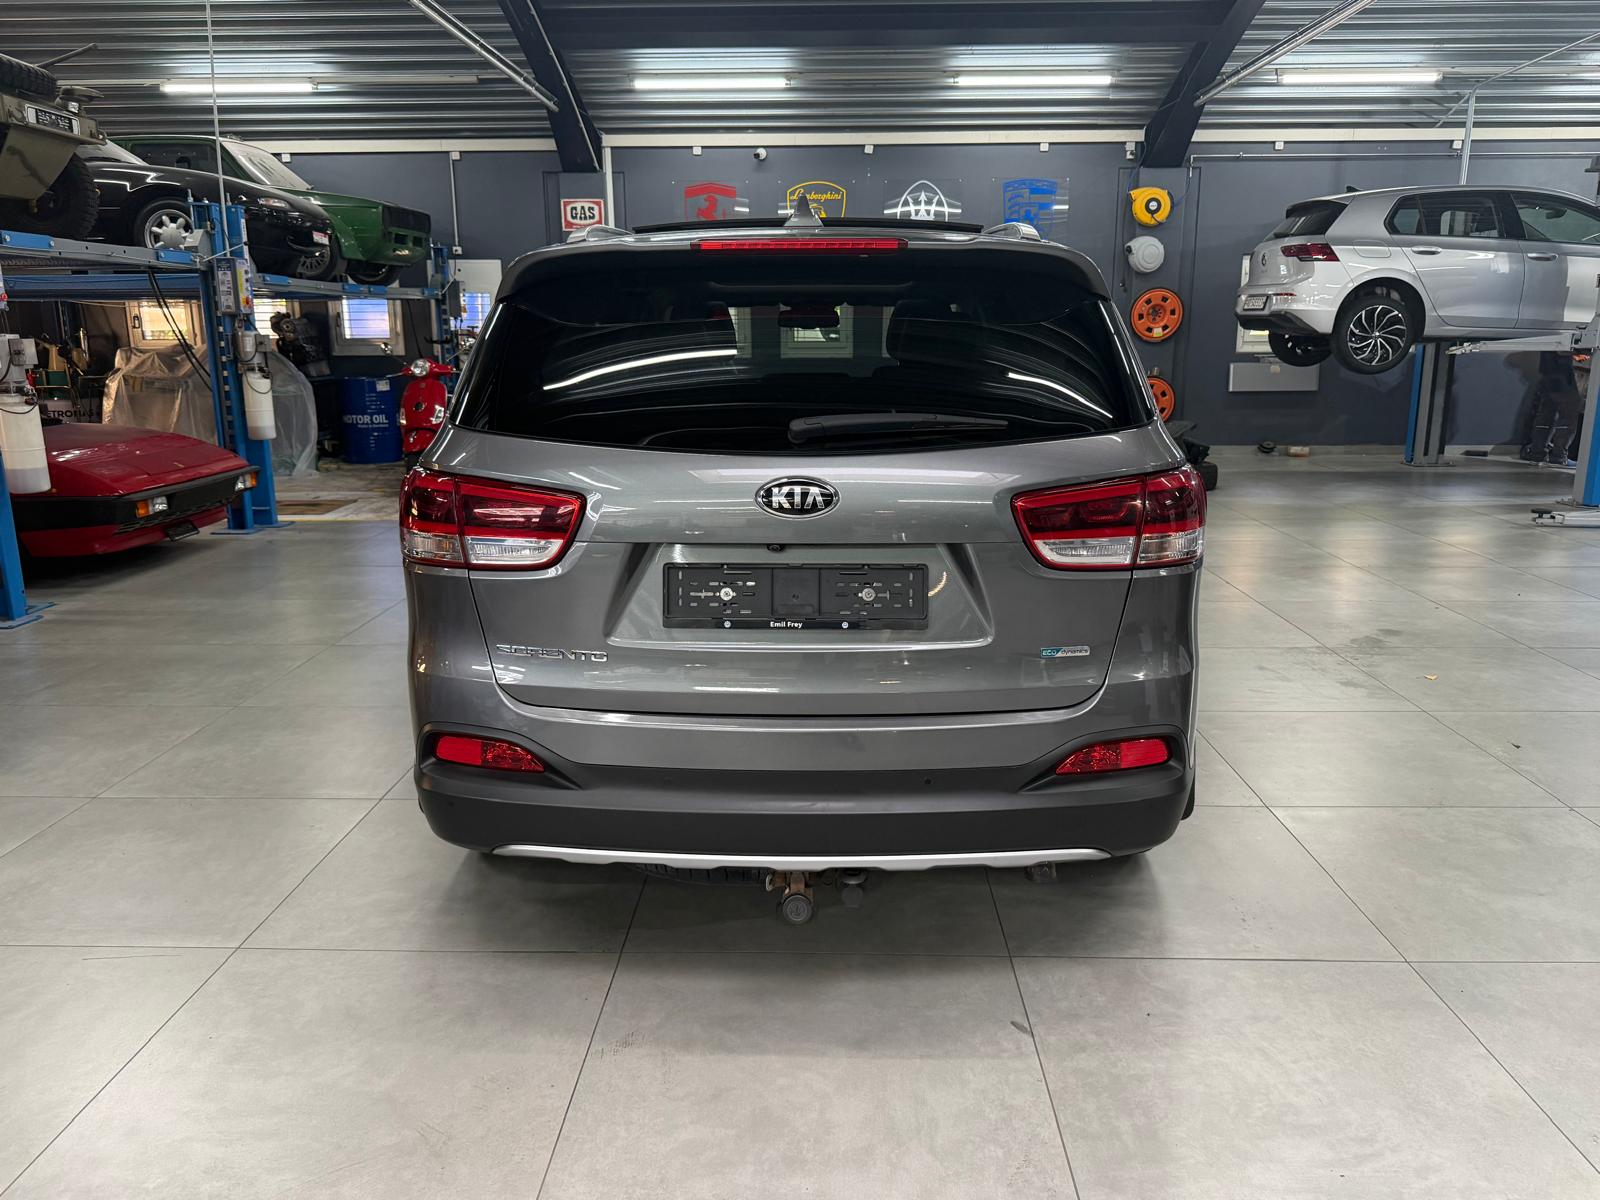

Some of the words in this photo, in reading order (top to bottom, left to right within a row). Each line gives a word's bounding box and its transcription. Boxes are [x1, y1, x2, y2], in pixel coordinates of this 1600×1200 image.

[570, 205, 596, 221] GAS
[372, 414, 389, 423] OIL
[771, 485, 826, 509] KIA
[787, 621, 803, 629] Frey
[496, 644, 608, 662] SORENTO
